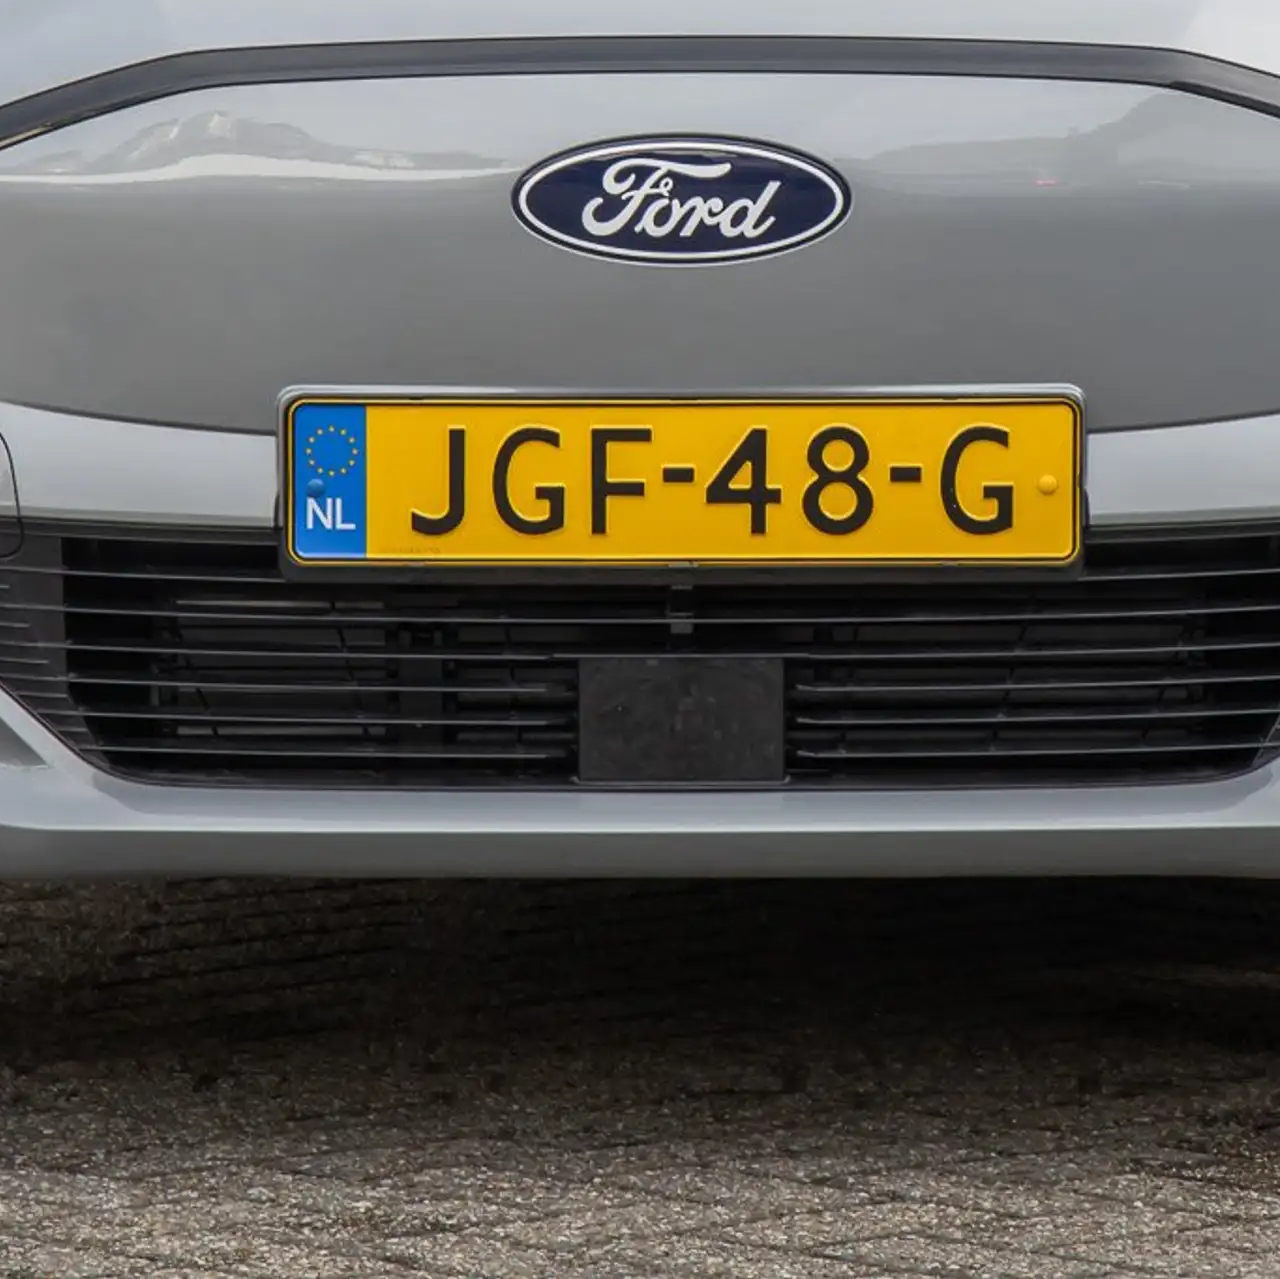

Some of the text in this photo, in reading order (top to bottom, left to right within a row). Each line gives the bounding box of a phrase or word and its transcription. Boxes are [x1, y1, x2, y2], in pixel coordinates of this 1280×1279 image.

[582, 156, 780, 239] Ford
[305, 497, 356, 531] NL
[410, 425, 1016, 537] JGF-48-G
